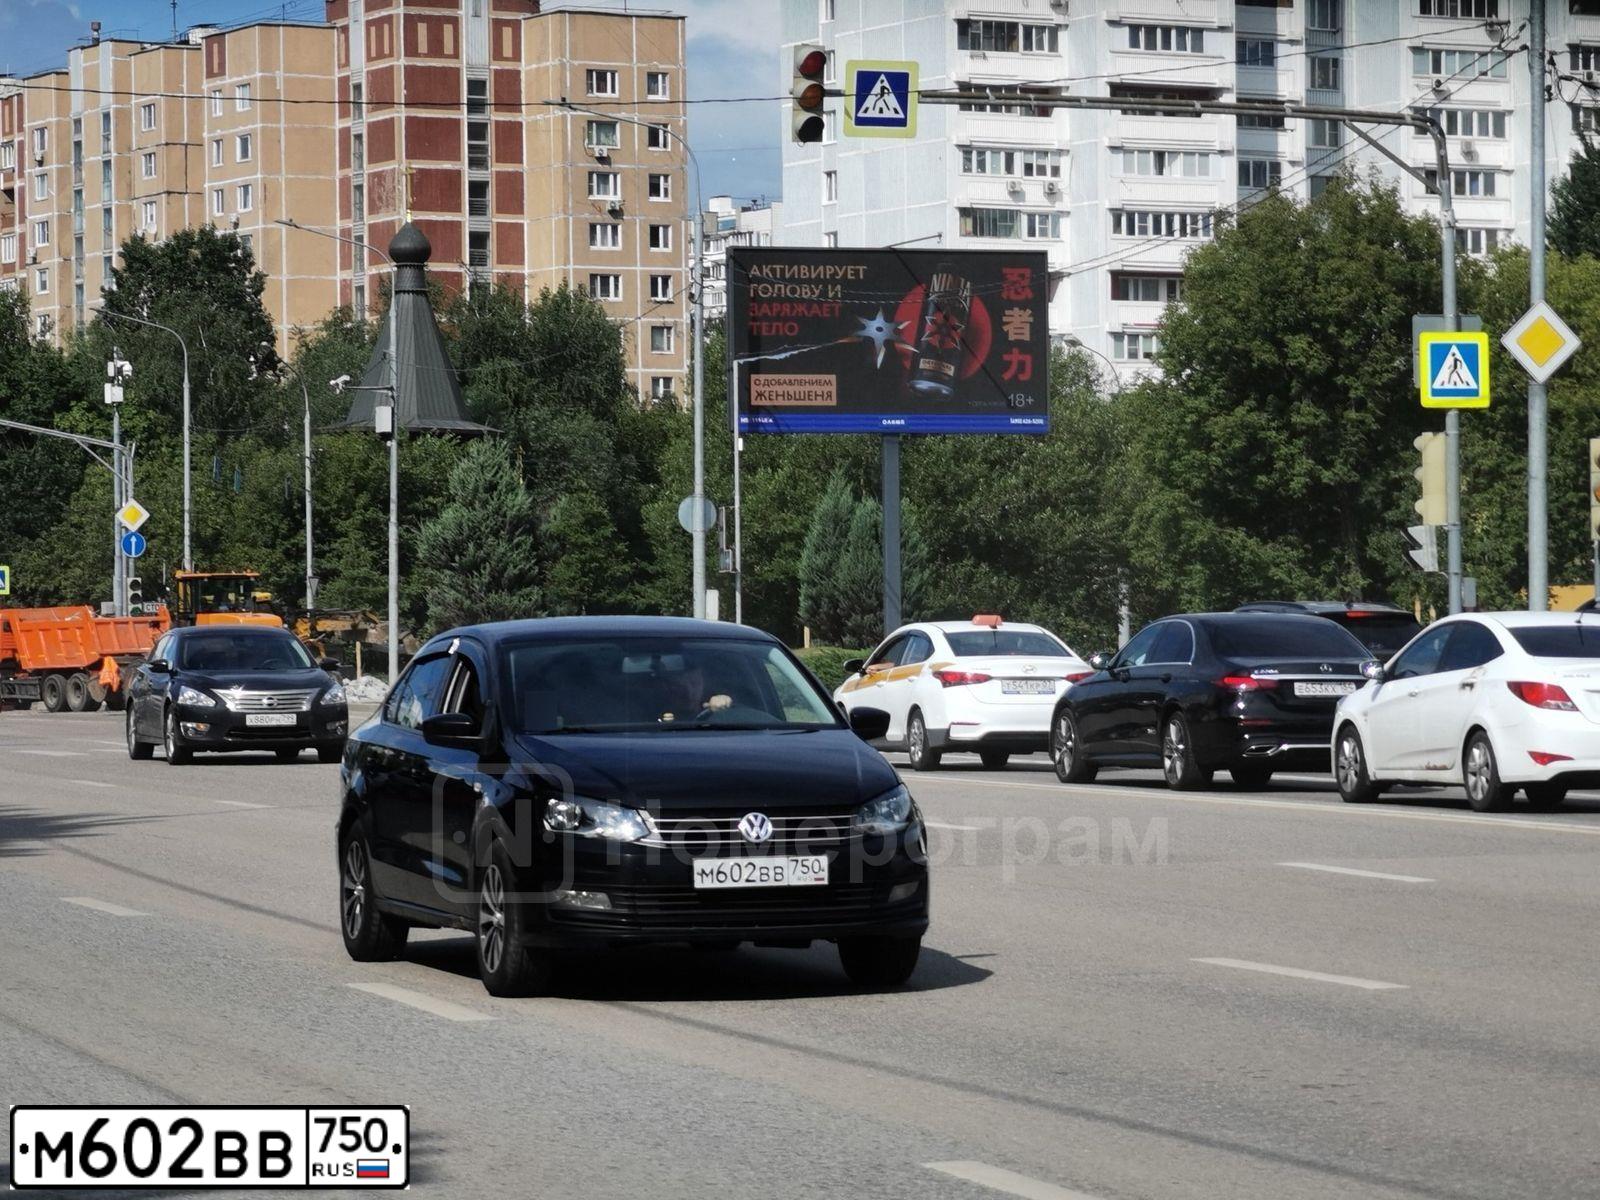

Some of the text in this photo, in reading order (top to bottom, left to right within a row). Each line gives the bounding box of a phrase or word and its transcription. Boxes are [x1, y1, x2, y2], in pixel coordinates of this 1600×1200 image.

[750, 264, 867, 279] АКТИВИРУЕТ
[749, 283, 842, 298] ГОЛОВУ И
[929, 273, 971, 306] NIJA
[749, 302, 843, 317] ЗАРЯЖАЕТ
[749, 321, 799, 336] ТЕЛО
[753, 378, 833, 388] С ДОБАВЛЕНИЕМ
[754, 390, 833, 402] ЖЕНЬШЕНЯ
[1008, 393, 1035, 408] 18+
[700, 858, 822, 884] М602ВВ 750
